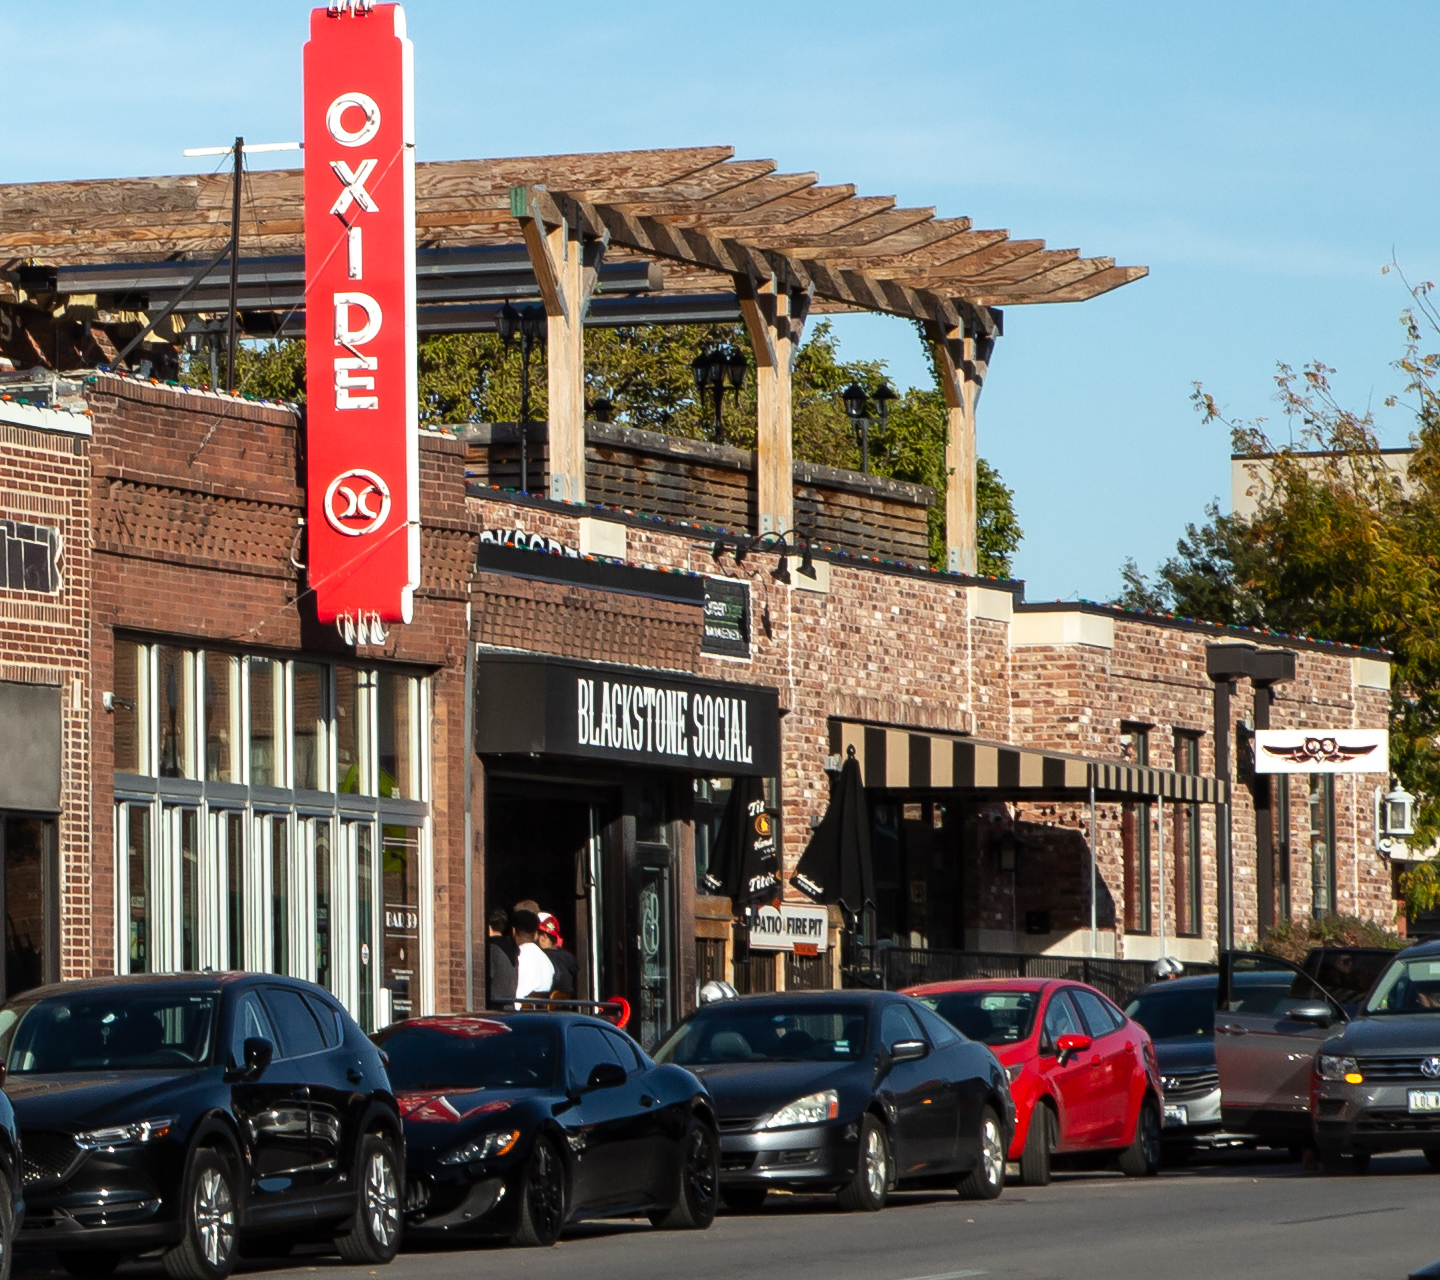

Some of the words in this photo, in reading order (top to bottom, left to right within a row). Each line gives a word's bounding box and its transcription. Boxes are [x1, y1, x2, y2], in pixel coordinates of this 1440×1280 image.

[326, 92, 382, 411] OXIDE
[578, 678, 688, 756] BLACKSTONE
[692, 693, 753, 764] SOCIAL
[386, 911, 404, 928] BAR
[754, 915, 782, 934] PATIO
